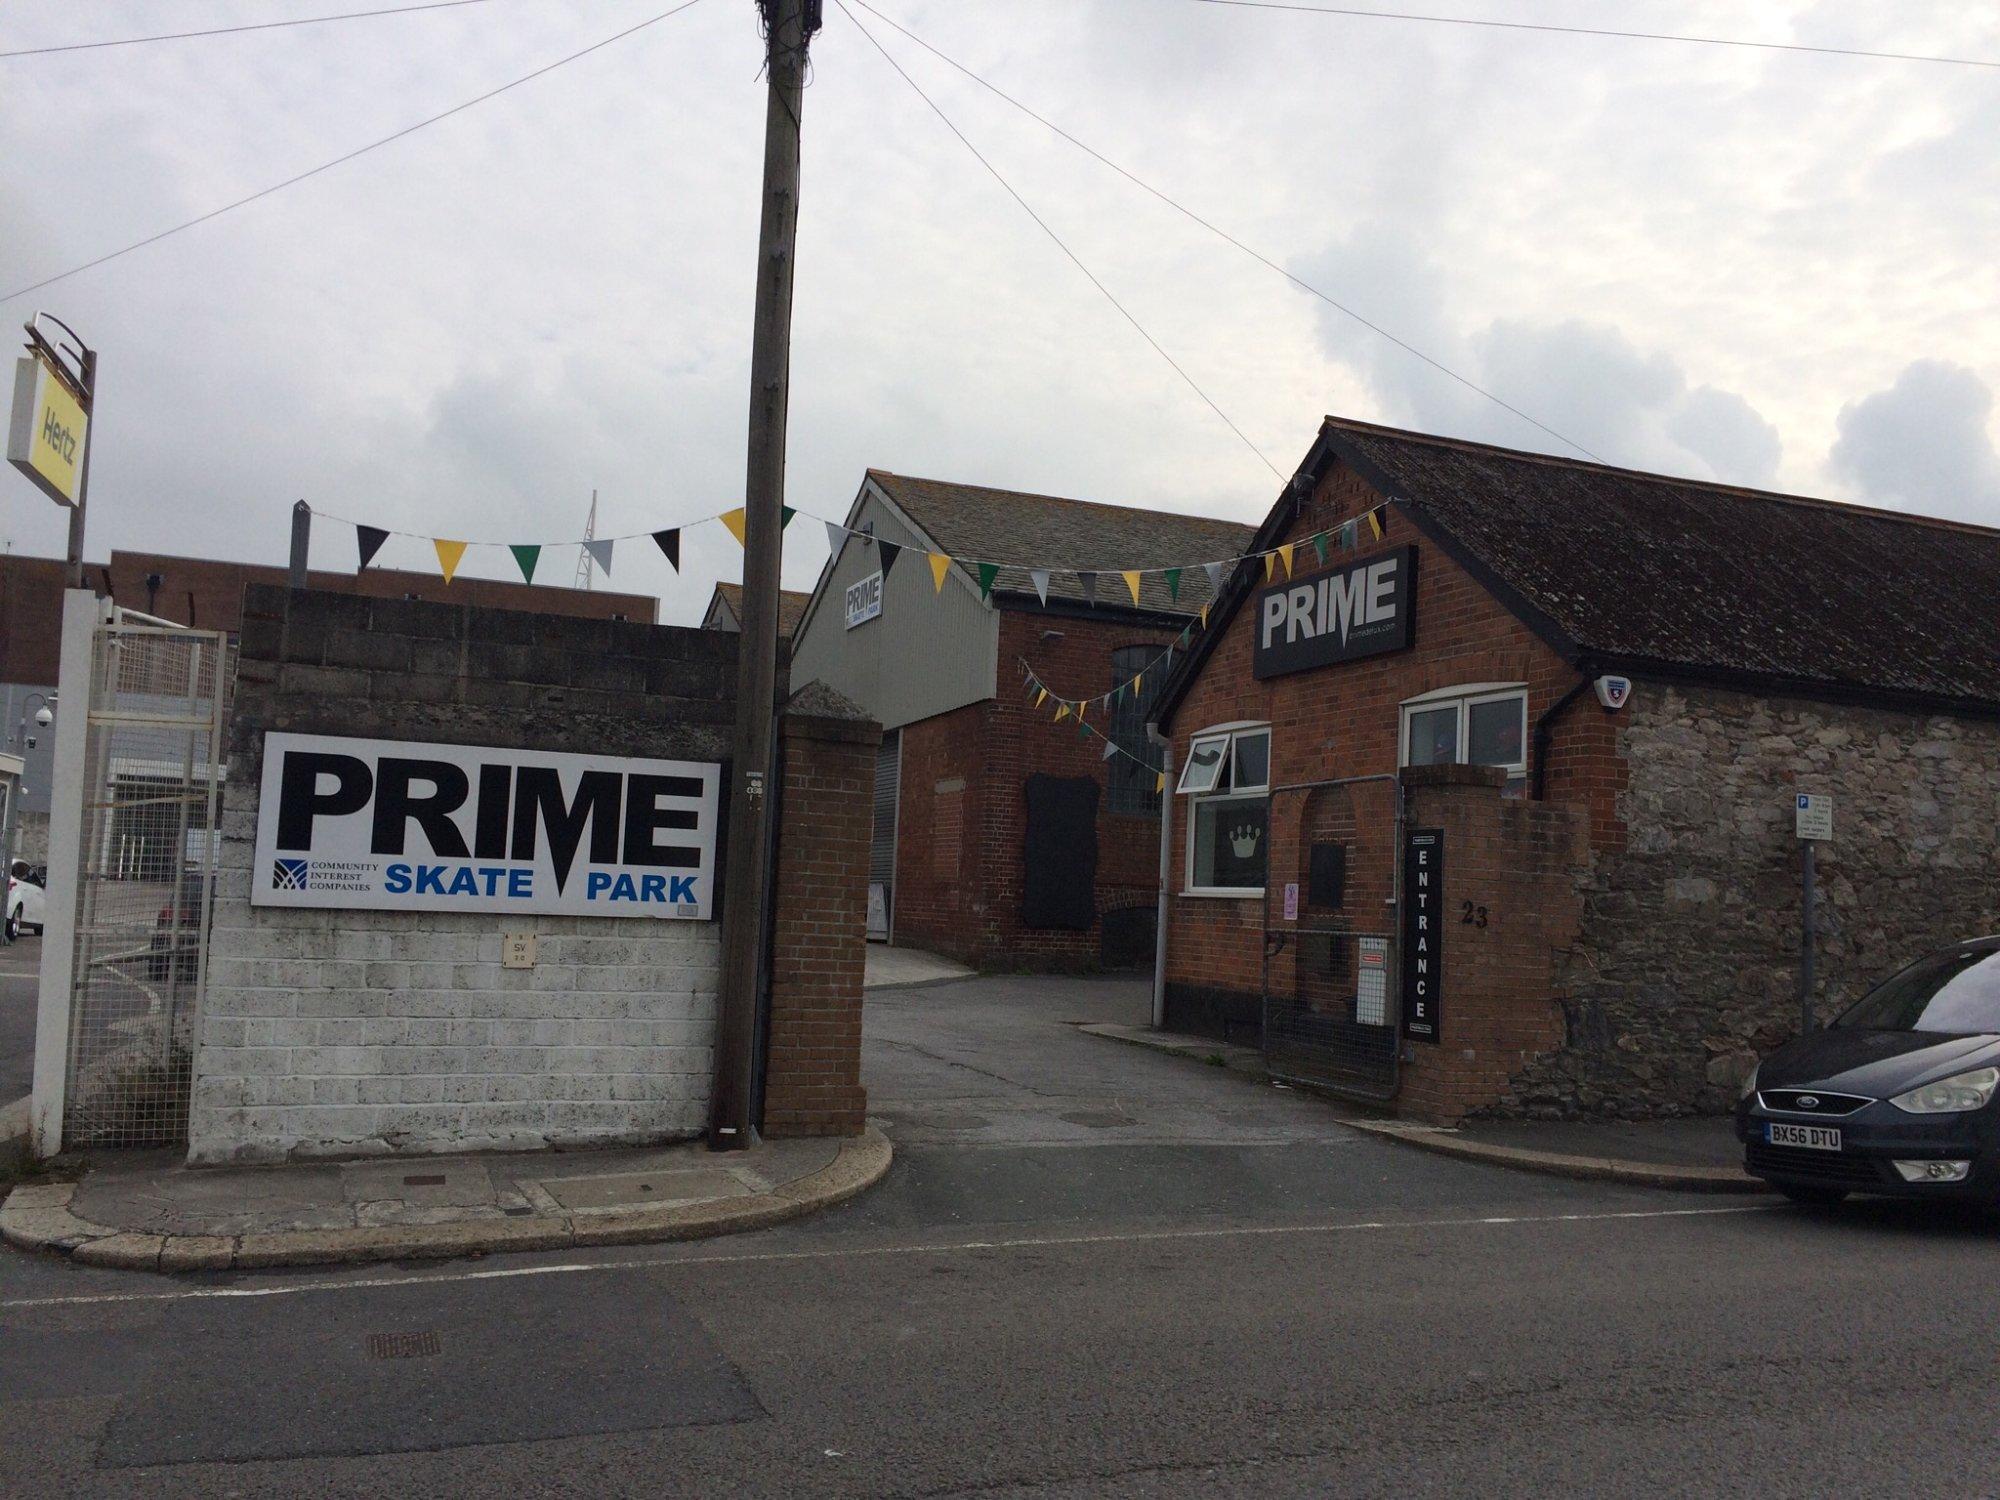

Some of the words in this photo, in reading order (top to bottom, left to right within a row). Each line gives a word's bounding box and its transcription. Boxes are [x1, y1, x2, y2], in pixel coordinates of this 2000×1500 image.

[43, 407, 76, 466] Hertz
[848, 576, 880, 616] PRIME
[1262, 558, 1397, 648] PRIME
[276, 751, 704, 898] PRIME
[310, 872, 362, 881] INTEREST
[311, 862, 379, 871] COMMUNITY
[384, 863, 534, 898] SKATE
[587, 872, 698, 903] PARK
[309, 882, 371, 891] COMPANIES
[1462, 900, 1489, 929] 23
[514, 943, 526, 952] SV
[1416, 850, 1428, 1017] ENTRANCE
[1772, 1126, 1807, 1143] BX56
[1811, 1130, 1838, 1147] DTU
